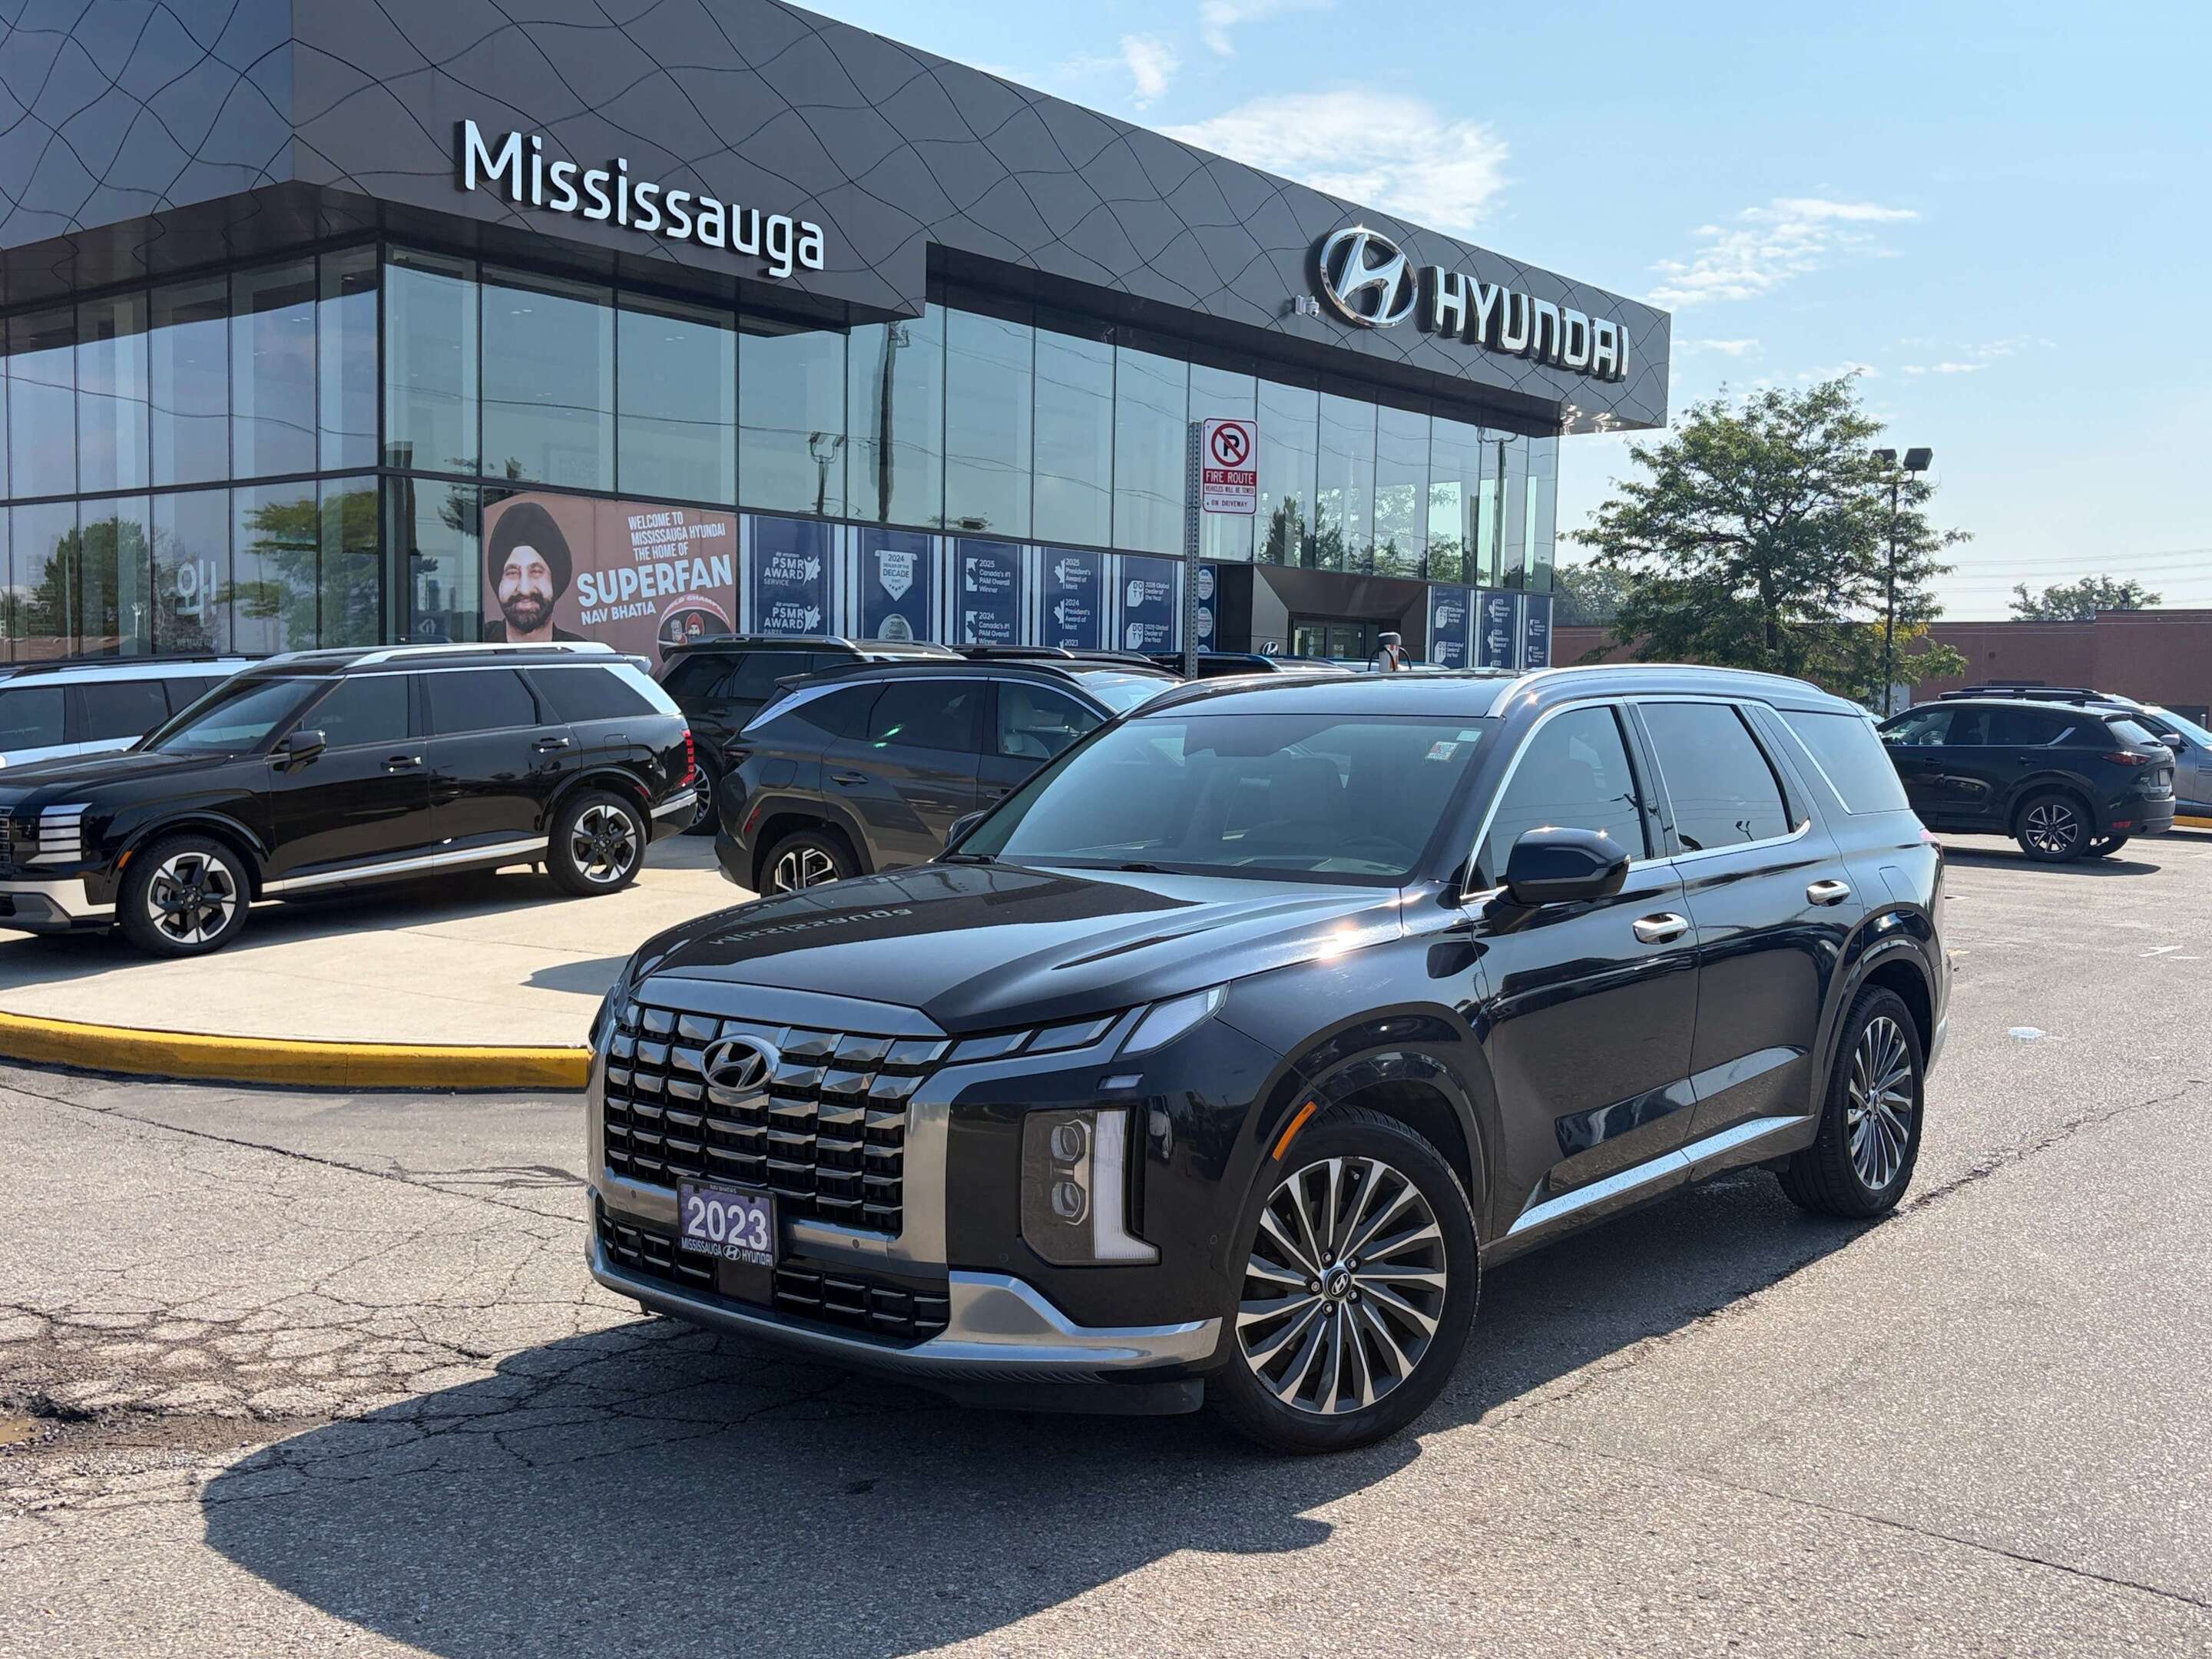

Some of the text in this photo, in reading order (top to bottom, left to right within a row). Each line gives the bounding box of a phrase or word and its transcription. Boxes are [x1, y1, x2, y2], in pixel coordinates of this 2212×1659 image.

[463, 119, 824, 279] Mississauga
[1431, 266, 1629, 382] HYUNDAI
[1206, 470, 1254, 485] FIRE ROUTE
[1221, 499, 1248, 508] DRIVEWAY
[628, 511, 684, 531] WELCOME TO
[631, 522, 726, 547] MISSISSAUGA HYUNDAI
[633, 541, 689, 561] THE HOME OF
[773, 556, 804, 570] PSMR
[888, 554, 905, 562] 2024
[979, 559, 995, 568] 2025
[1065, 558, 1081, 567] 2025
[763, 567, 804, 580] AWARD
[882, 568, 910, 578] DECADE
[979, 569, 1004, 578] Canada's
[576, 554, 733, 608] SUPERFAN
[763, 578, 790, 587] SERVICE
[992, 578, 1010, 586] Overall
[979, 585, 998, 594] Winner
[581, 601, 657, 626] NAV BHATIA
[773, 607, 804, 619] PSMR
[979, 611, 995, 621] 2024
[763, 617, 804, 629] AWARD
[979, 621, 1003, 630] Canada's
[687, 1196, 768, 1251] 2023
[681, 1237, 773, 1267] MISSISSAUGA HYUNDAI
